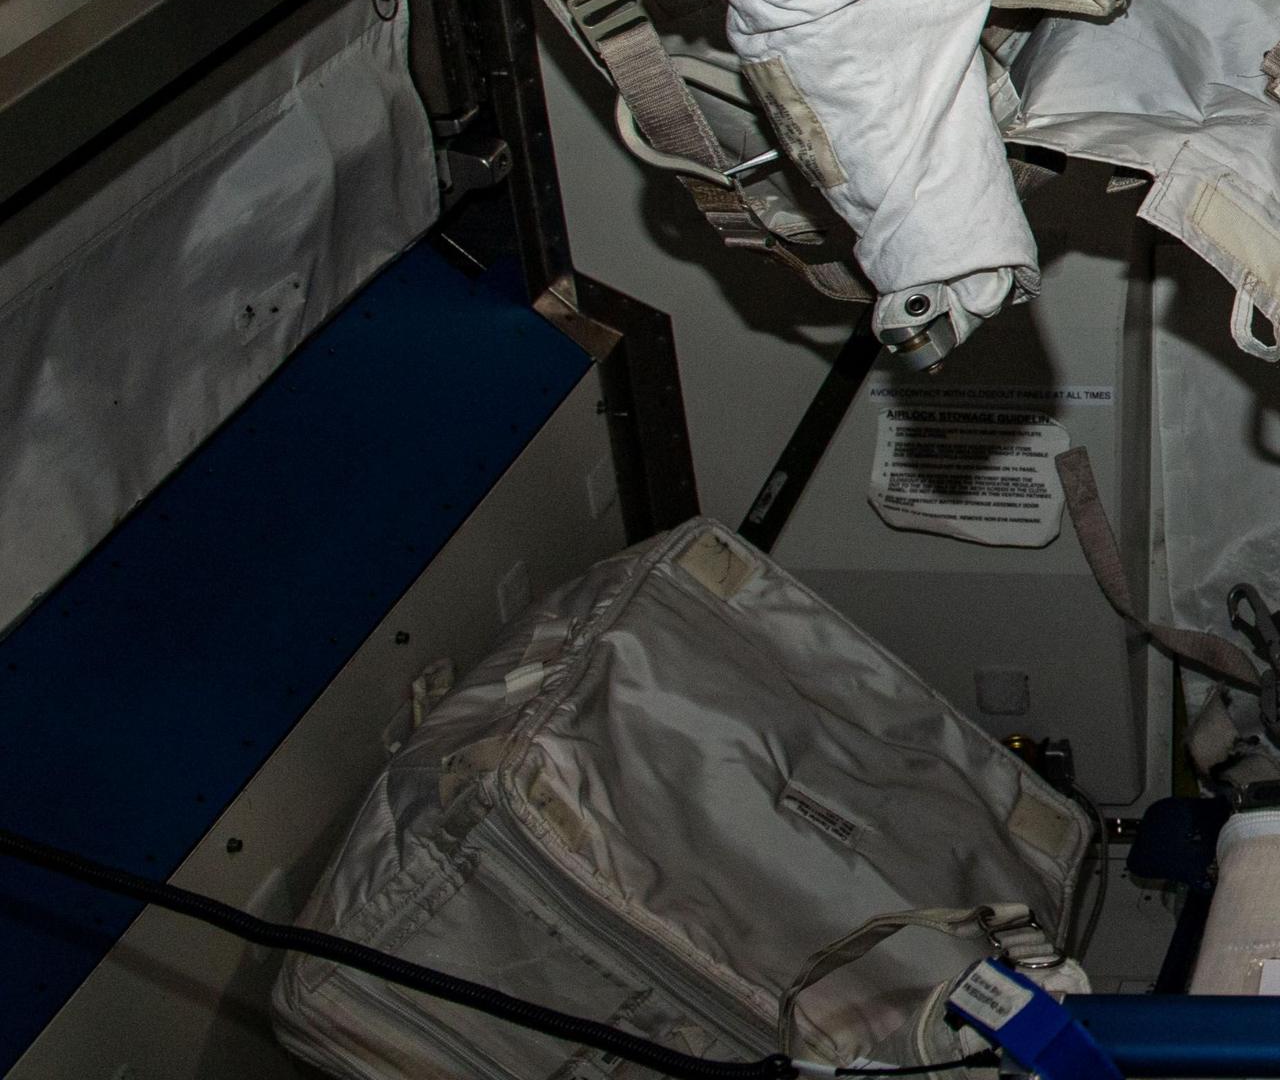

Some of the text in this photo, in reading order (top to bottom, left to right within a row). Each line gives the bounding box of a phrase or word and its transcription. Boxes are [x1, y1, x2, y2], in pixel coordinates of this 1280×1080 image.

[1054, 391, 1065, 400] AT
[1066, 391, 1082, 400] ALL
[1084, 391, 1112, 401] TIMES
[886, 408, 937, 421] AIRLOCK
[938, 410, 996, 423] STOWAGE
